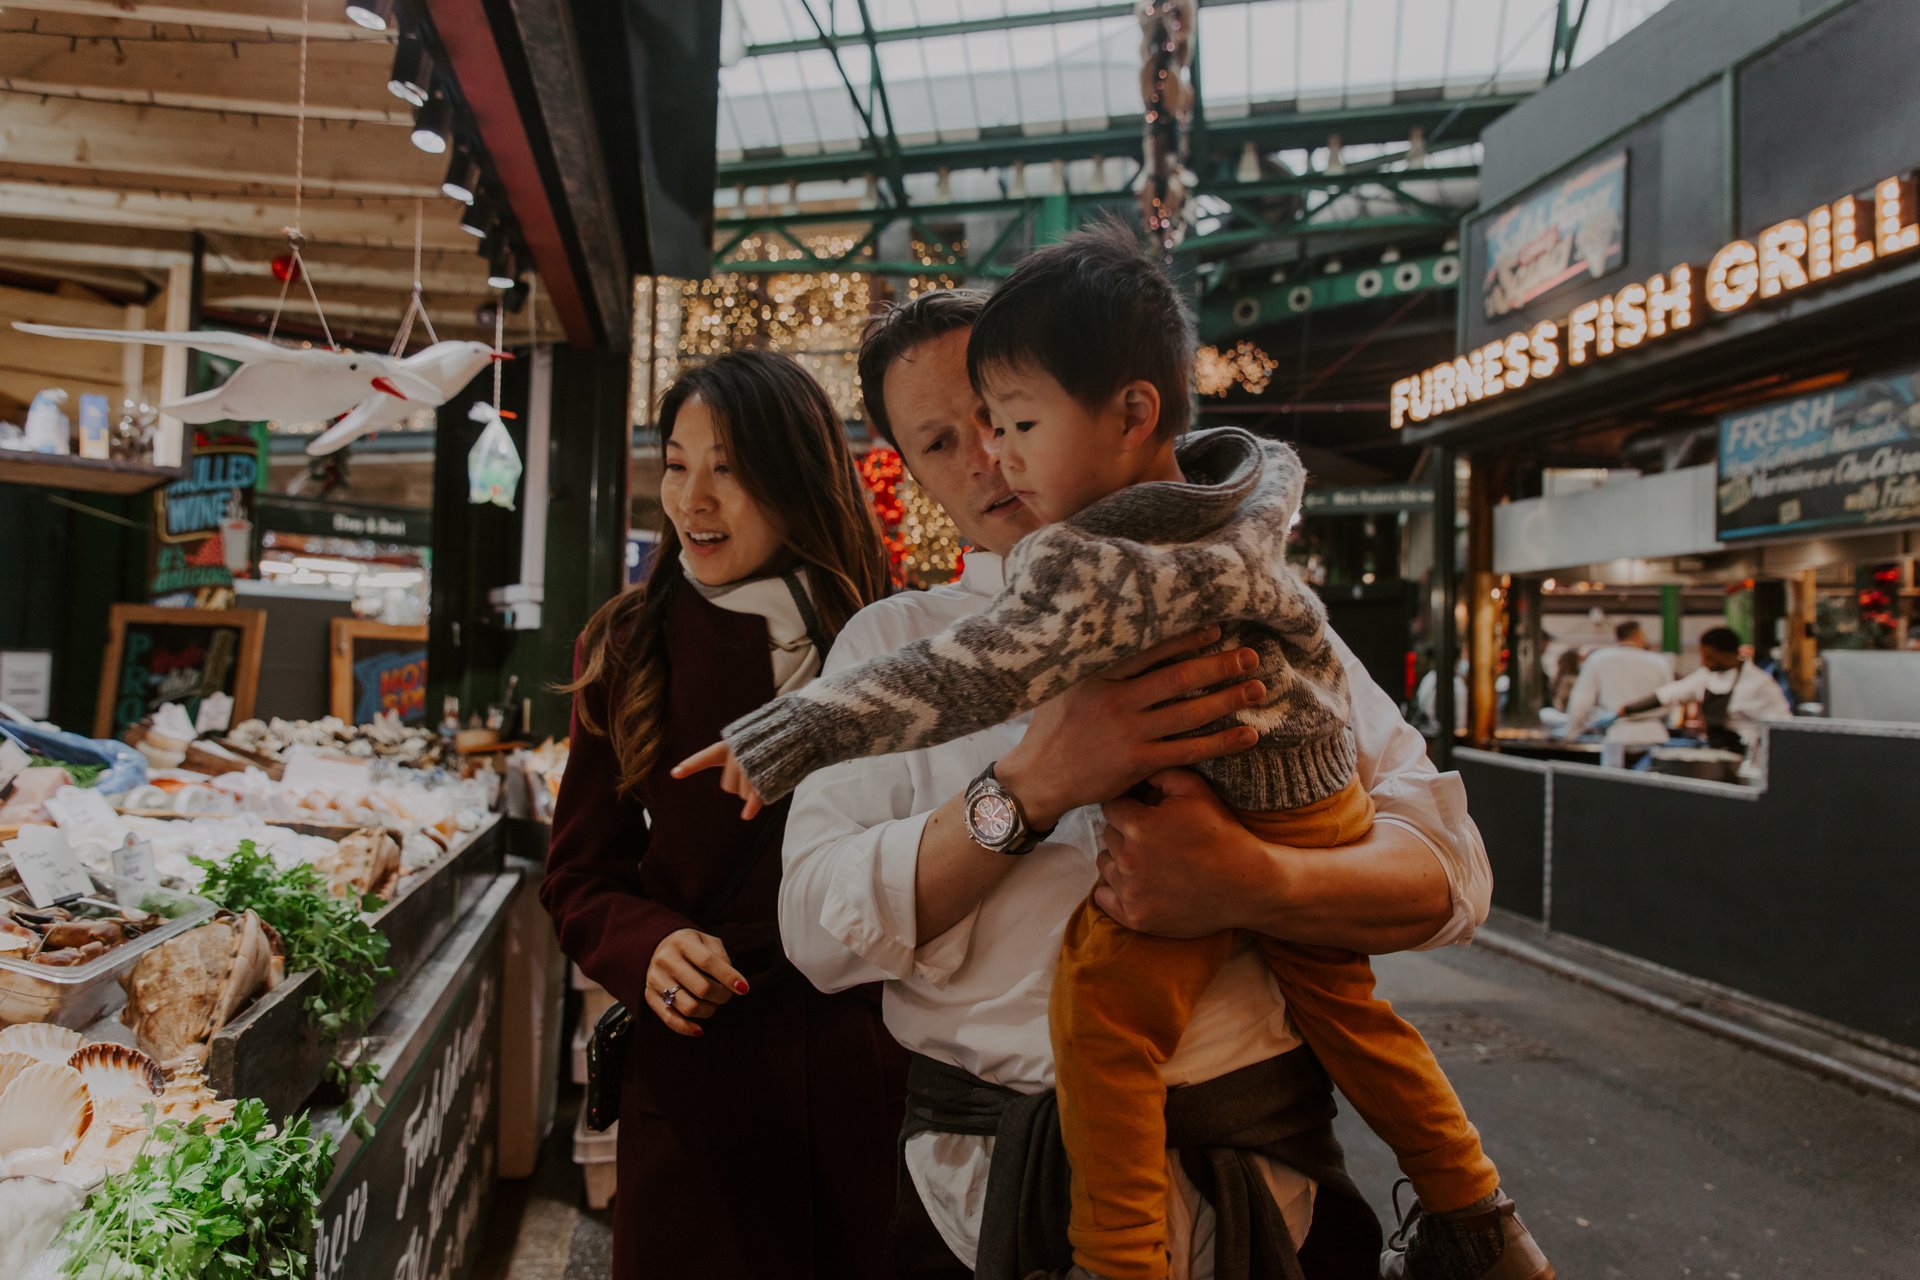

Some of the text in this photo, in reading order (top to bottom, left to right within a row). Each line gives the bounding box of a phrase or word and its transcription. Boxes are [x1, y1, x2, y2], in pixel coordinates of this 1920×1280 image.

[1390, 175, 1920, 430] FURNESS FISH GRILL
[1725, 392, 1836, 456] FRESH
